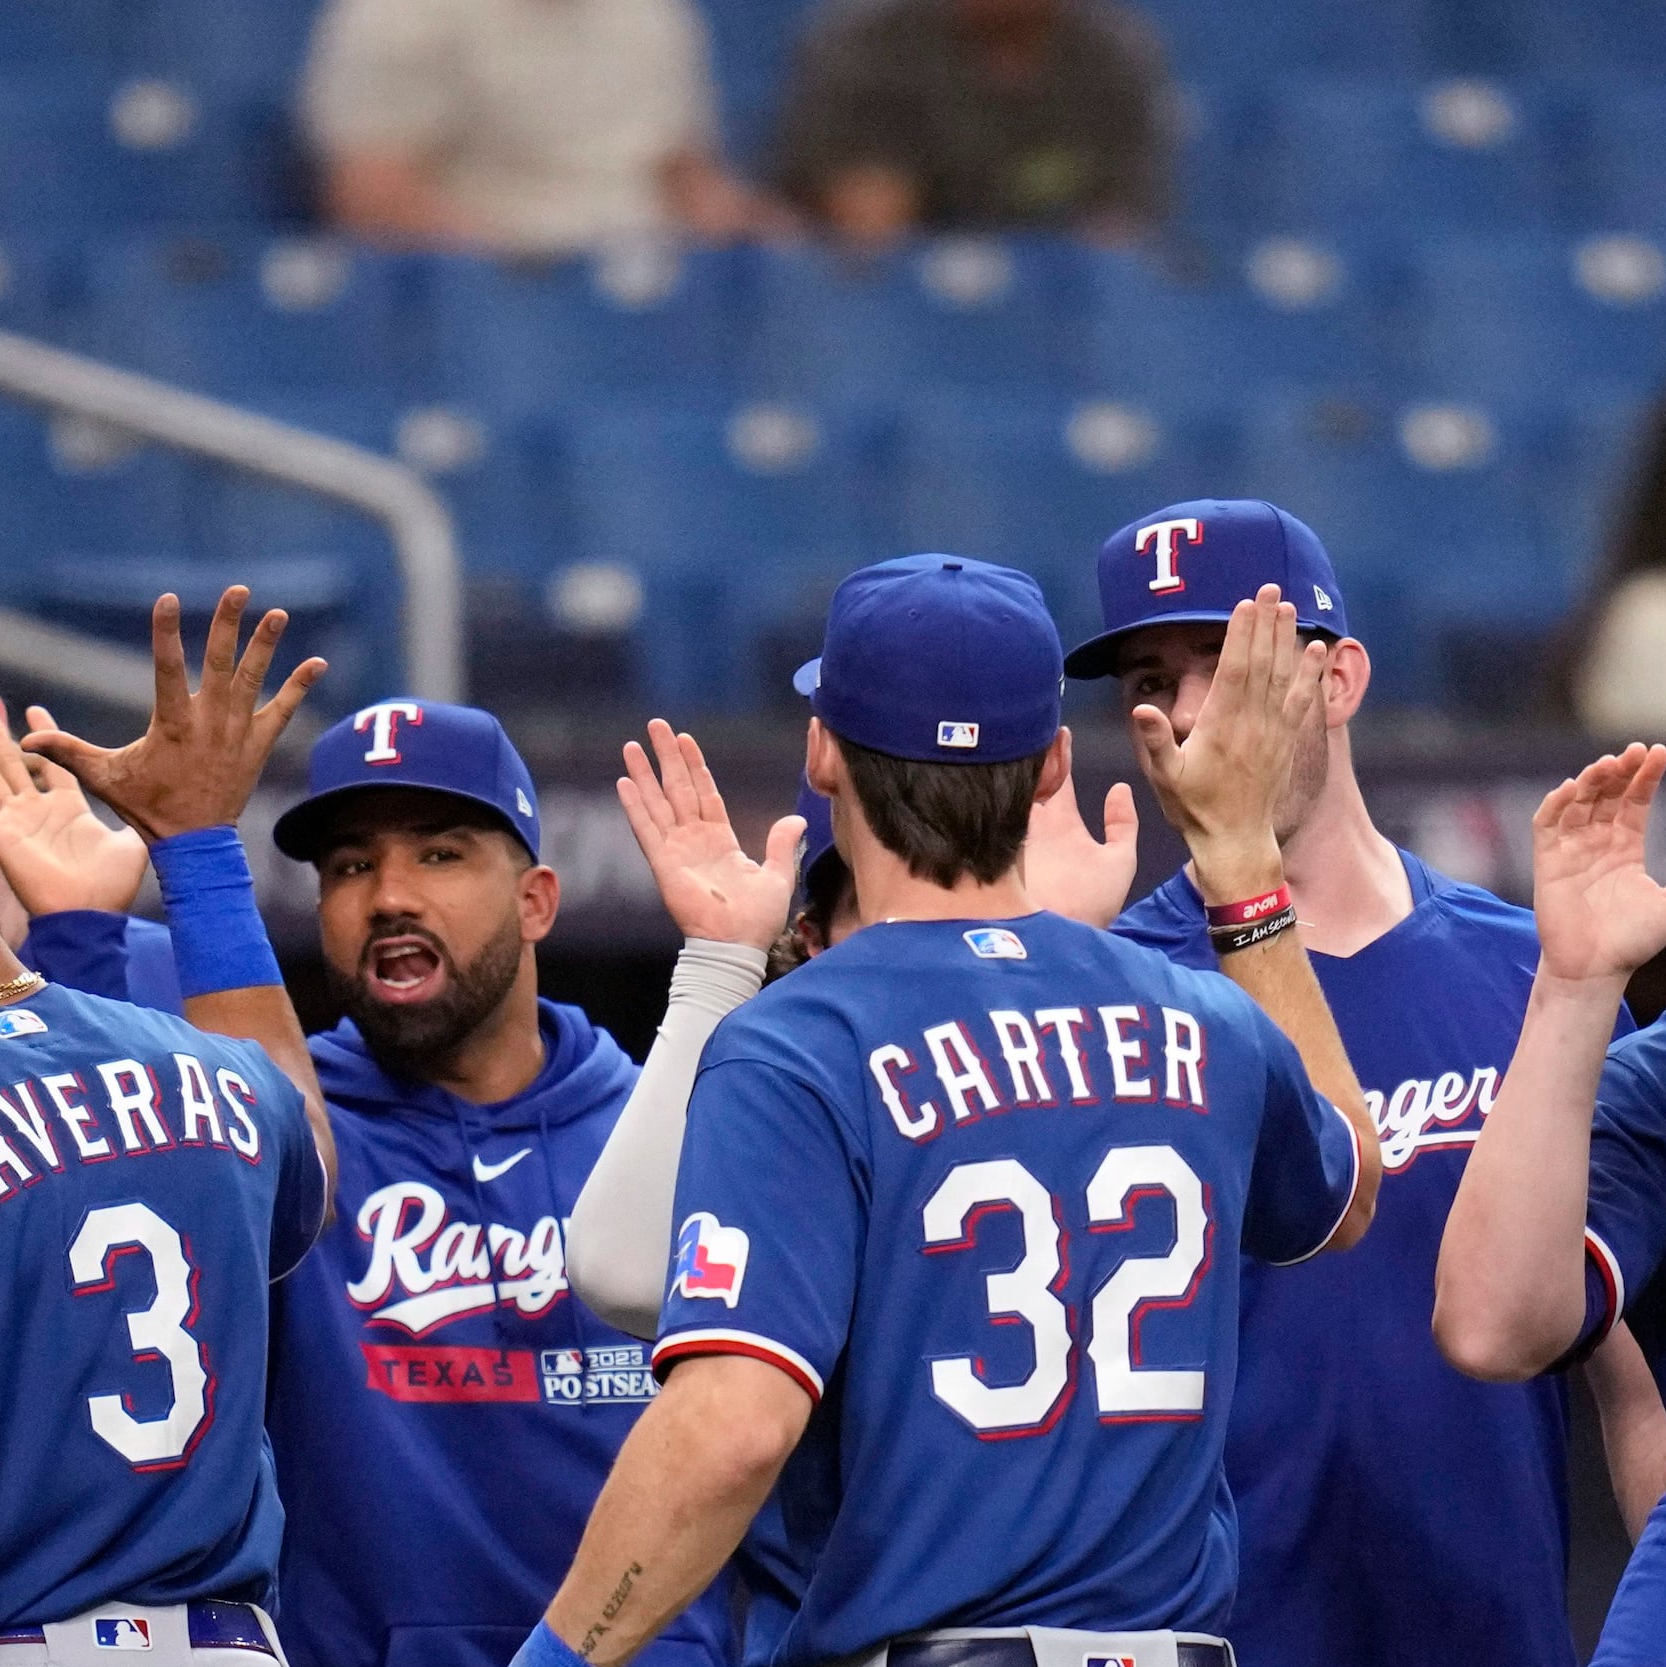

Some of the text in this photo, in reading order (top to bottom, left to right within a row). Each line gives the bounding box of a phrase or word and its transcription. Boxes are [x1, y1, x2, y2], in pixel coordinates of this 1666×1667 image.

[1135, 517, 1203, 595] T
[354, 702, 422, 766] T
[868, 1005, 1210, 1144] CARTER
[1362, 1066, 1502, 1176] nger
[347, 1181, 570, 1333] Rang
[919, 1144, 1214, 1441] 32
[68, 1201, 217, 1472] 3
[382, 1347, 515, 1389] TEXAS
[587, 1350, 643, 1368] 2023
[544, 1371, 662, 1399] POSTSEA
